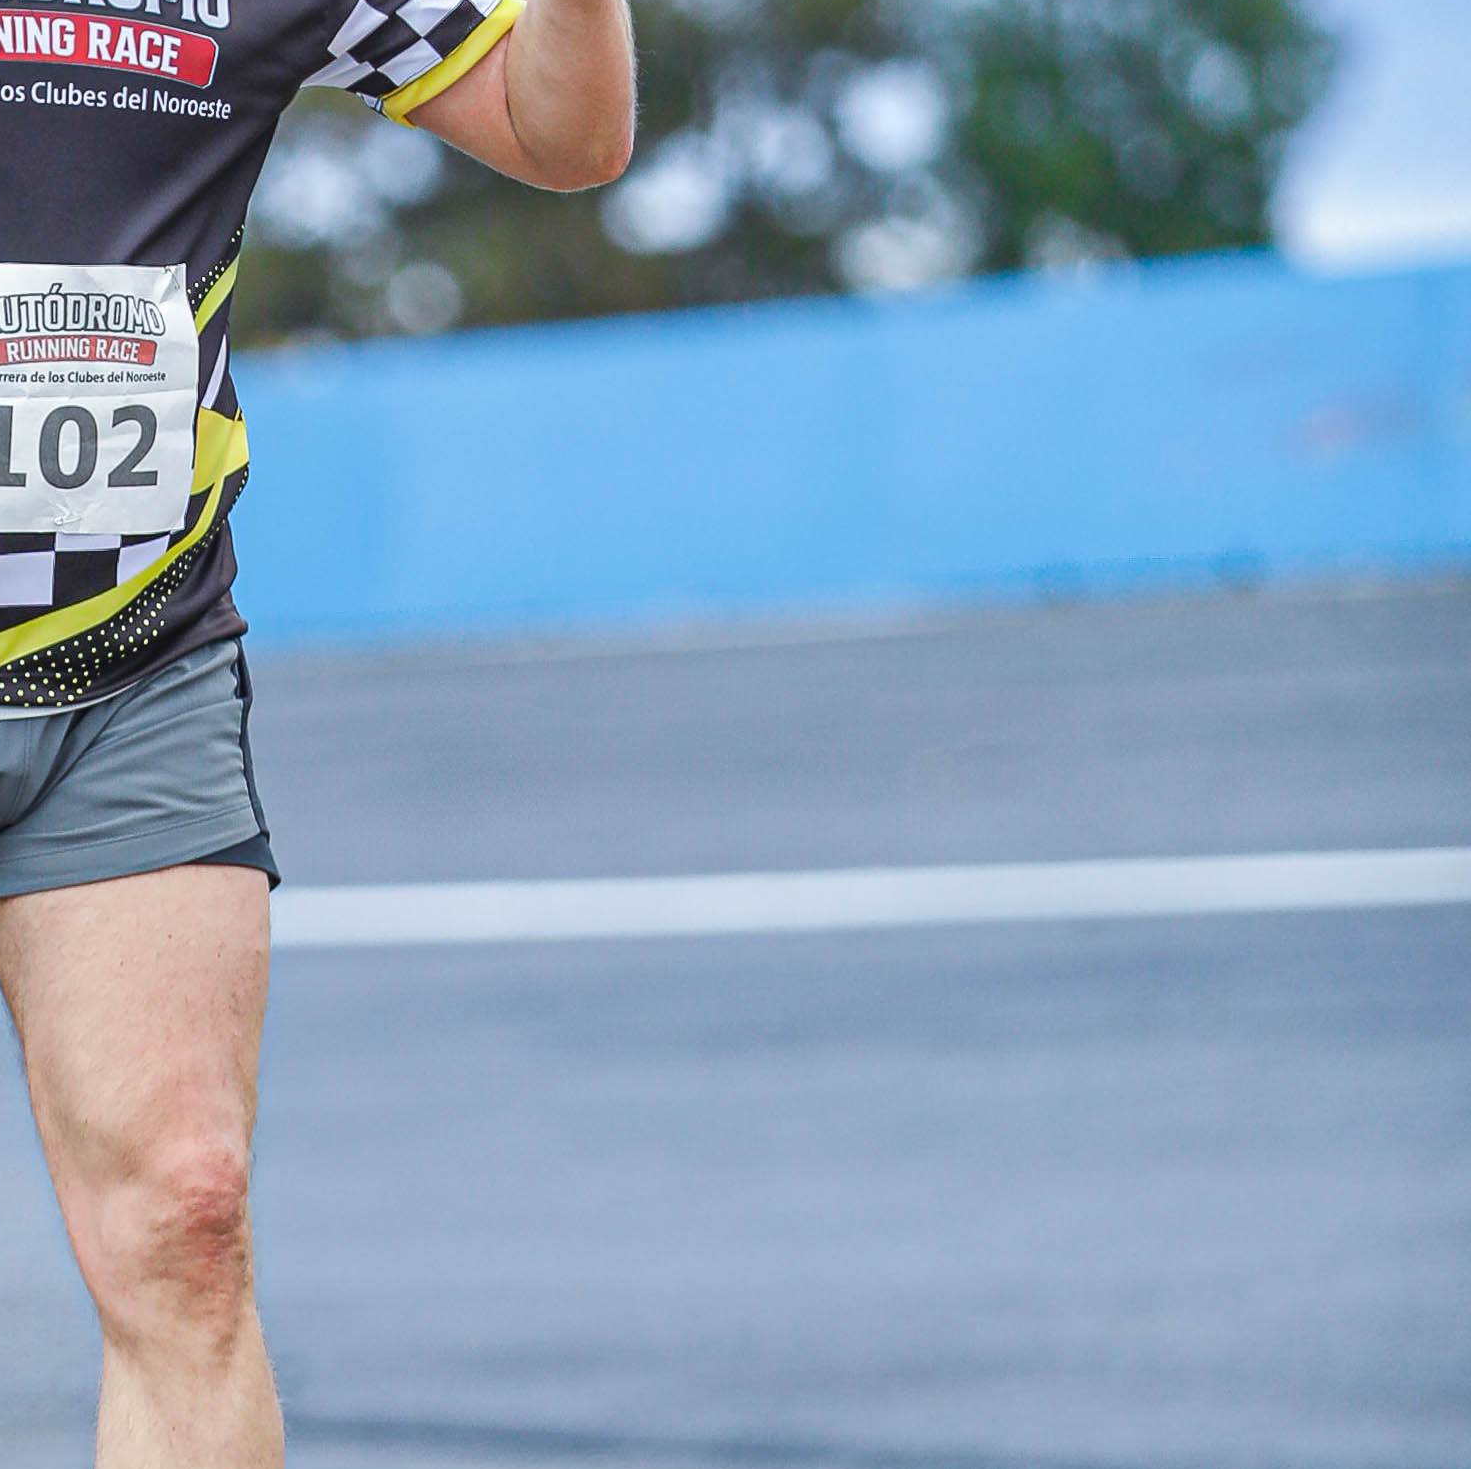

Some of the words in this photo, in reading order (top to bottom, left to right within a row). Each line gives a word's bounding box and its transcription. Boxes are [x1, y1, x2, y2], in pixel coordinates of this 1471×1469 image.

[87, 20, 183, 75] RACE
[31, 81, 107, 107] Clubes
[112, 86, 148, 110] del
[153, 90, 232, 119] Noroeste
[5, 337, 90, 361] RUNNING
[95, 339, 141, 362] RACE
[30, 371, 46, 383] de
[48, 371, 65, 383] los
[67, 371, 105, 383] Clubes
[107, 371, 124, 383] del
[126, 370, 167, 383] Noroeste
